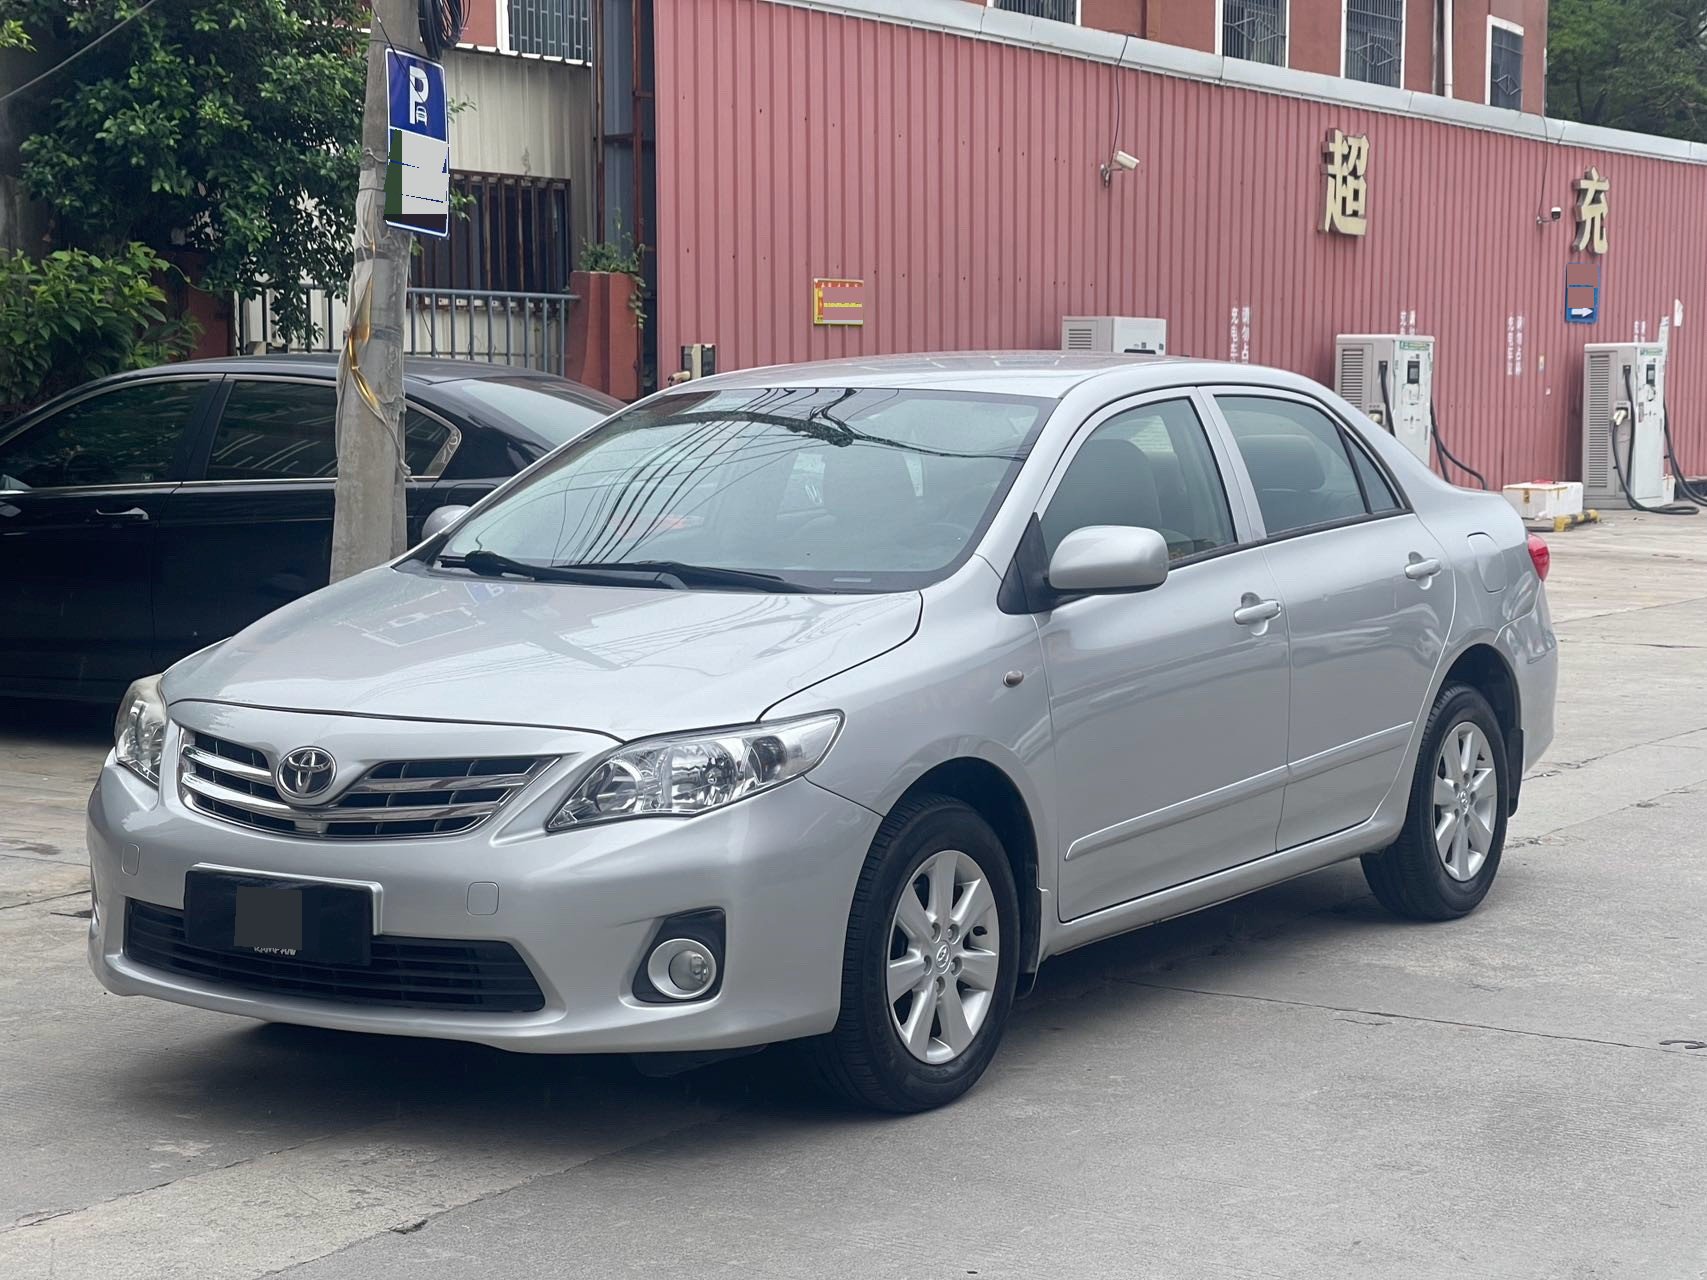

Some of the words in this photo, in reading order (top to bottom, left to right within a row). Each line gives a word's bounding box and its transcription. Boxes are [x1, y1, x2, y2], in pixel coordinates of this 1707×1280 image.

[409, 65, 429, 124] P
[1321, 128, 1369, 236] 超
[1576, 166, 1609, 254] 充
